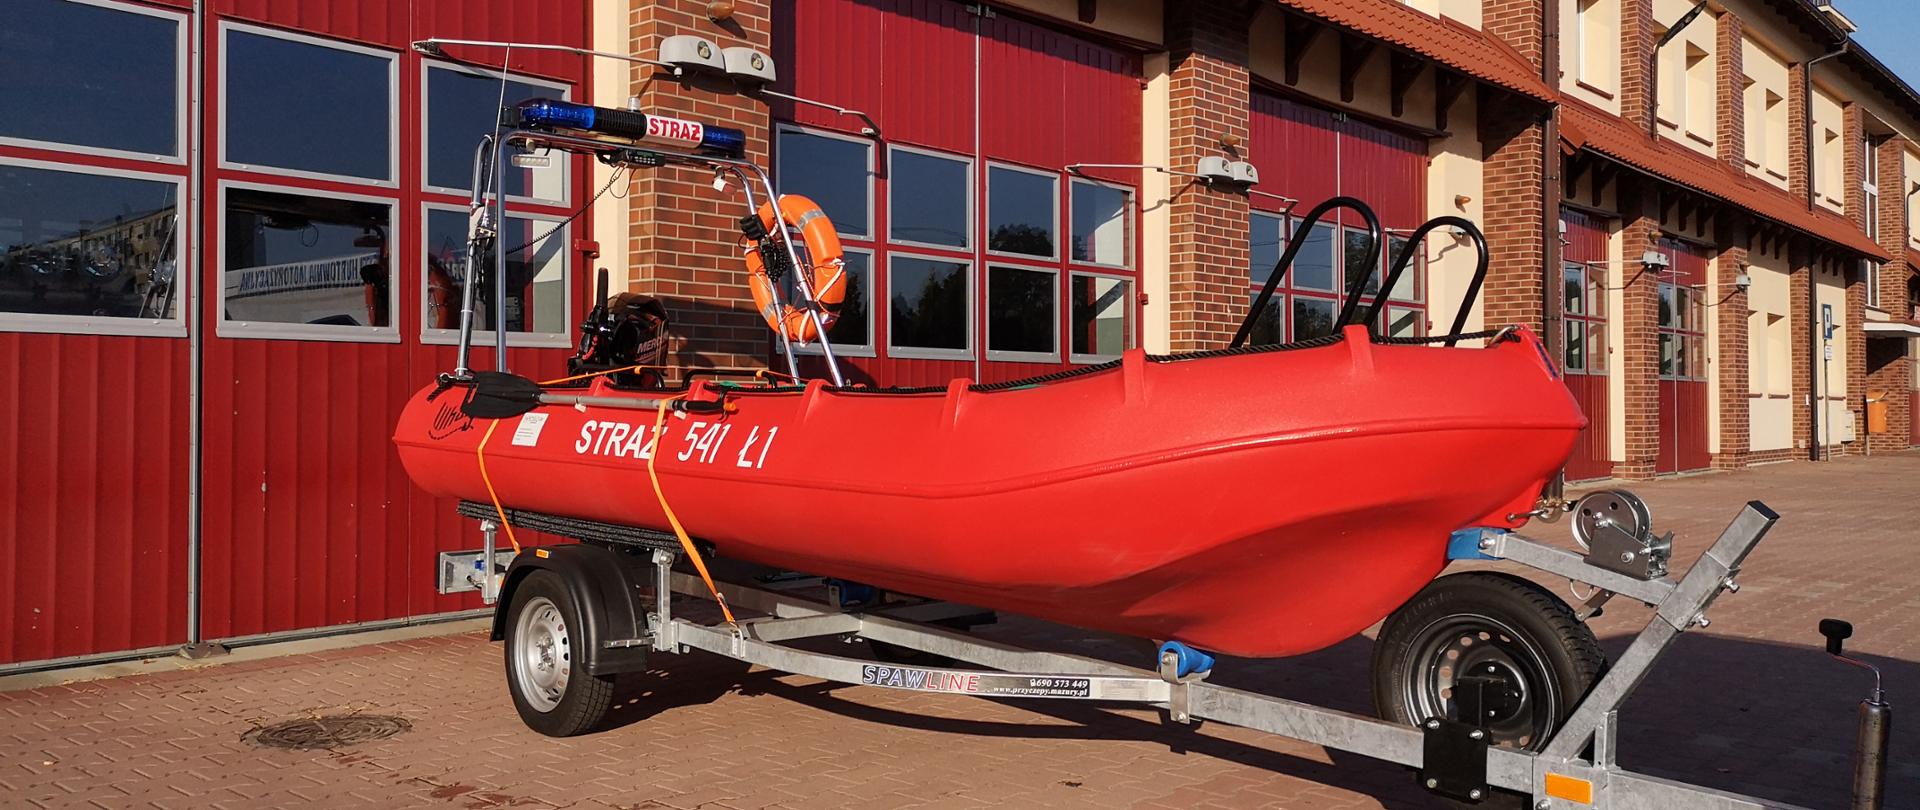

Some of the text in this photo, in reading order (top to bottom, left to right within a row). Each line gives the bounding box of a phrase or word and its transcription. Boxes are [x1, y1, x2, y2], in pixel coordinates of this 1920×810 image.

[677, 421, 732, 464] 541
[863, 665, 980, 692] SPAWLINE
[1072, 680, 1088, 688] 449
